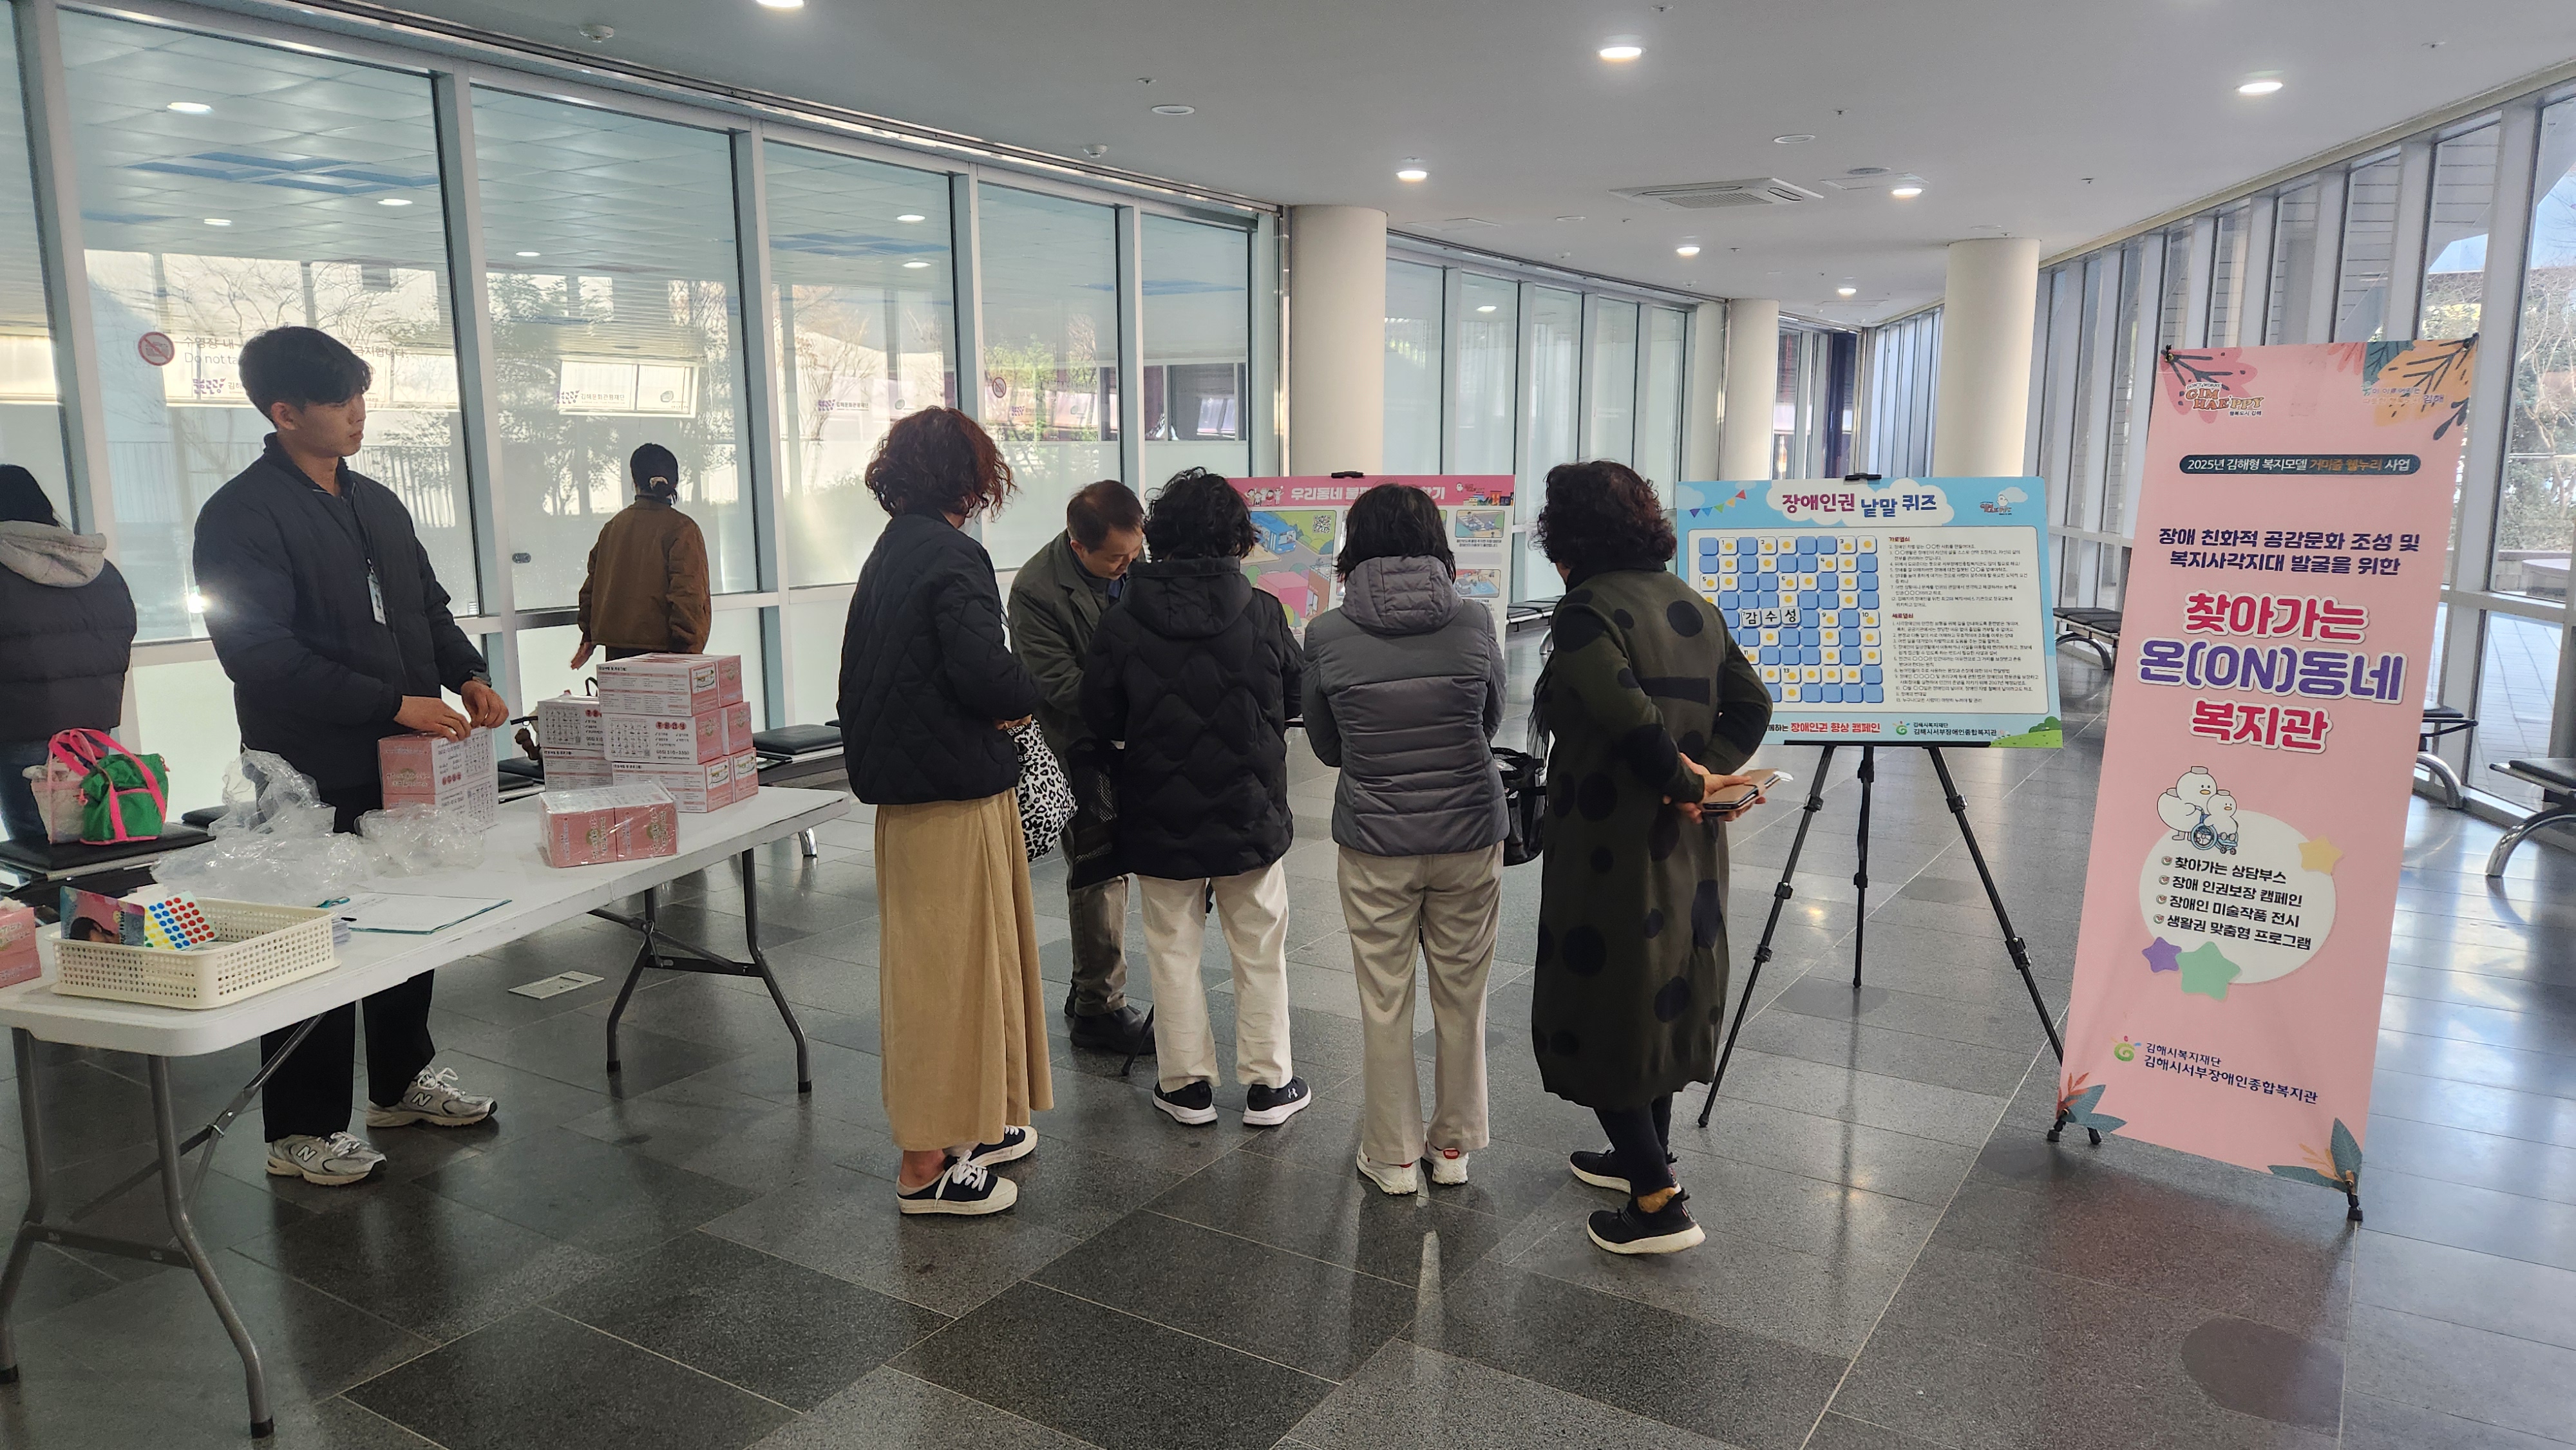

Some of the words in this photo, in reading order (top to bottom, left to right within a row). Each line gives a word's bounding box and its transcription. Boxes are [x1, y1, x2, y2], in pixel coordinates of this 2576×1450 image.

[183, 336, 219, 349] 수영장
[223, 338, 234, 350] 내
[185, 352, 202, 362] Do
[205, 355, 225, 364] not
[2185, 388, 2219, 399] GIM
[2187, 459, 2224, 471] 2025년
[2227, 459, 2260, 471] 김해형
[2262, 458, 2307, 471] 복지모델
[2385, 459, 2410, 471] 사업
[1291, 487, 1343, 500] 우리동네
[1782, 493, 1855, 513] 장애인권
[1861, 498, 1897, 518] 낱말
[1902, 493, 1937, 511] 퀴즈
[2159, 528, 2195, 545] 장애
[2201, 529, 2259, 547] 친화적
[2264, 531, 2345, 551] 공감문화
[2350, 532, 2393, 552] 조성
[2399, 533, 2420, 552] 및
[2170, 550, 2285, 572] 복지사각지대
[2290, 554, 2352, 574] 발굴을
[2358, 556, 2401, 576] 위한
[1746, 613, 1757, 625] 감
[1765, 611, 1777, 622] 수
[1785, 609, 1796, 623] 성
[2186, 592, 2364, 640] 찾아가는
[2141, 639, 2403, 701] 온(ON)동네
[1790, 722, 1828, 733] 장애인권
[1831, 722, 1850, 733] 향상
[1852, 722, 1880, 733] 캠페인
[2192, 700, 2329, 751] 복지관
[2175, 856, 2228, 876] 찾아가는
[2232, 865, 2287, 885] 상담부스
[2172, 876, 2198, 891] 장애
[2202, 880, 2257, 900] 인권보장
[2260, 889, 2303, 908] 캠페인
[2170, 895, 2209, 913] 장애인
[2212, 902, 2267, 923] 미술작품
[2271, 911, 2300, 928] 전시
[2167, 914, 2206, 933] 생활권
[2210, 922, 2251, 940] 맞춤형
[2254, 929, 2311, 951] 프로그램
[2146, 1042, 2222, 1068] 김해시복지재단
[2144, 1055, 2318, 1105] 김해시서부장애인종합복지관
[411, 1092, 432, 1106] N
[296, 1145, 317, 1162] N
